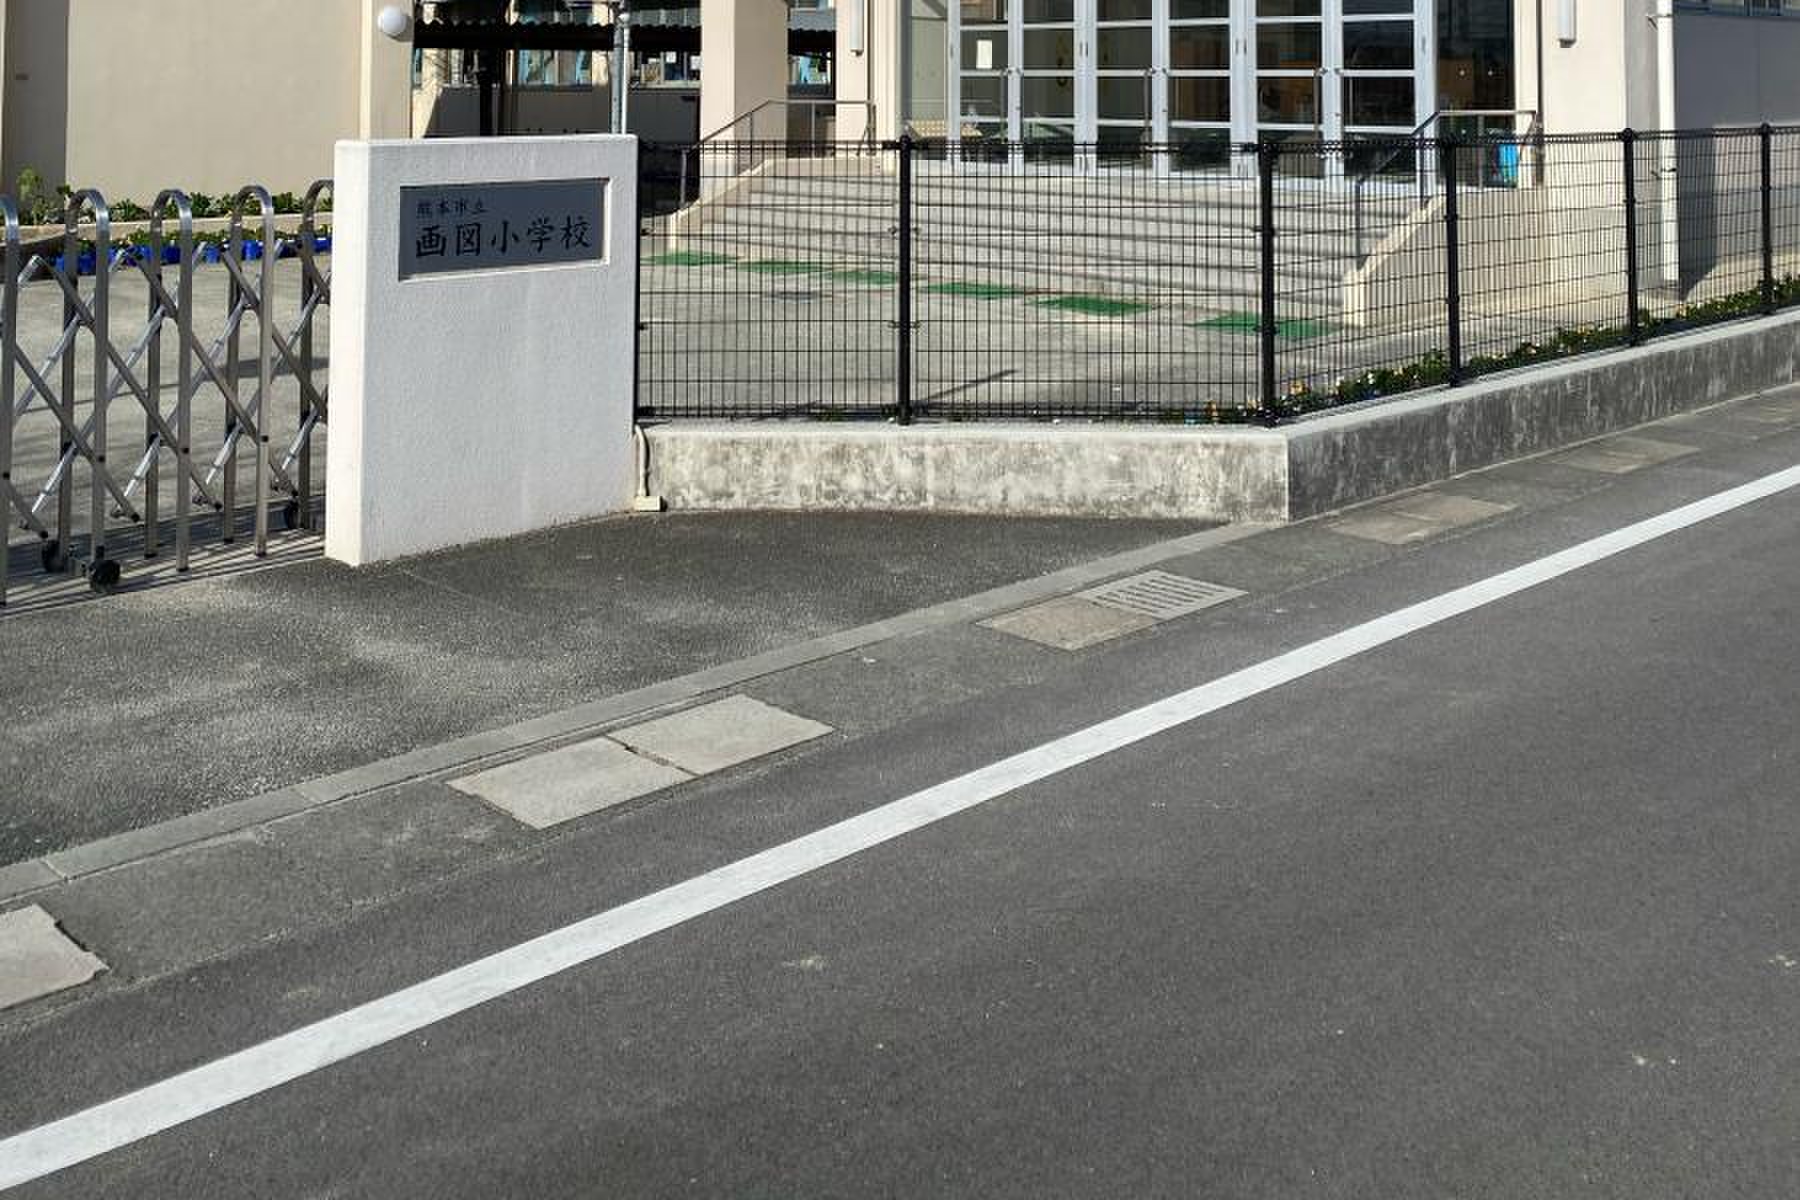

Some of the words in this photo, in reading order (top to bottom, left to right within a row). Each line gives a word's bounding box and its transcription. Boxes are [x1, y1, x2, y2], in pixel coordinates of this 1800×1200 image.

[416, 216, 592, 257] 画図小学校
